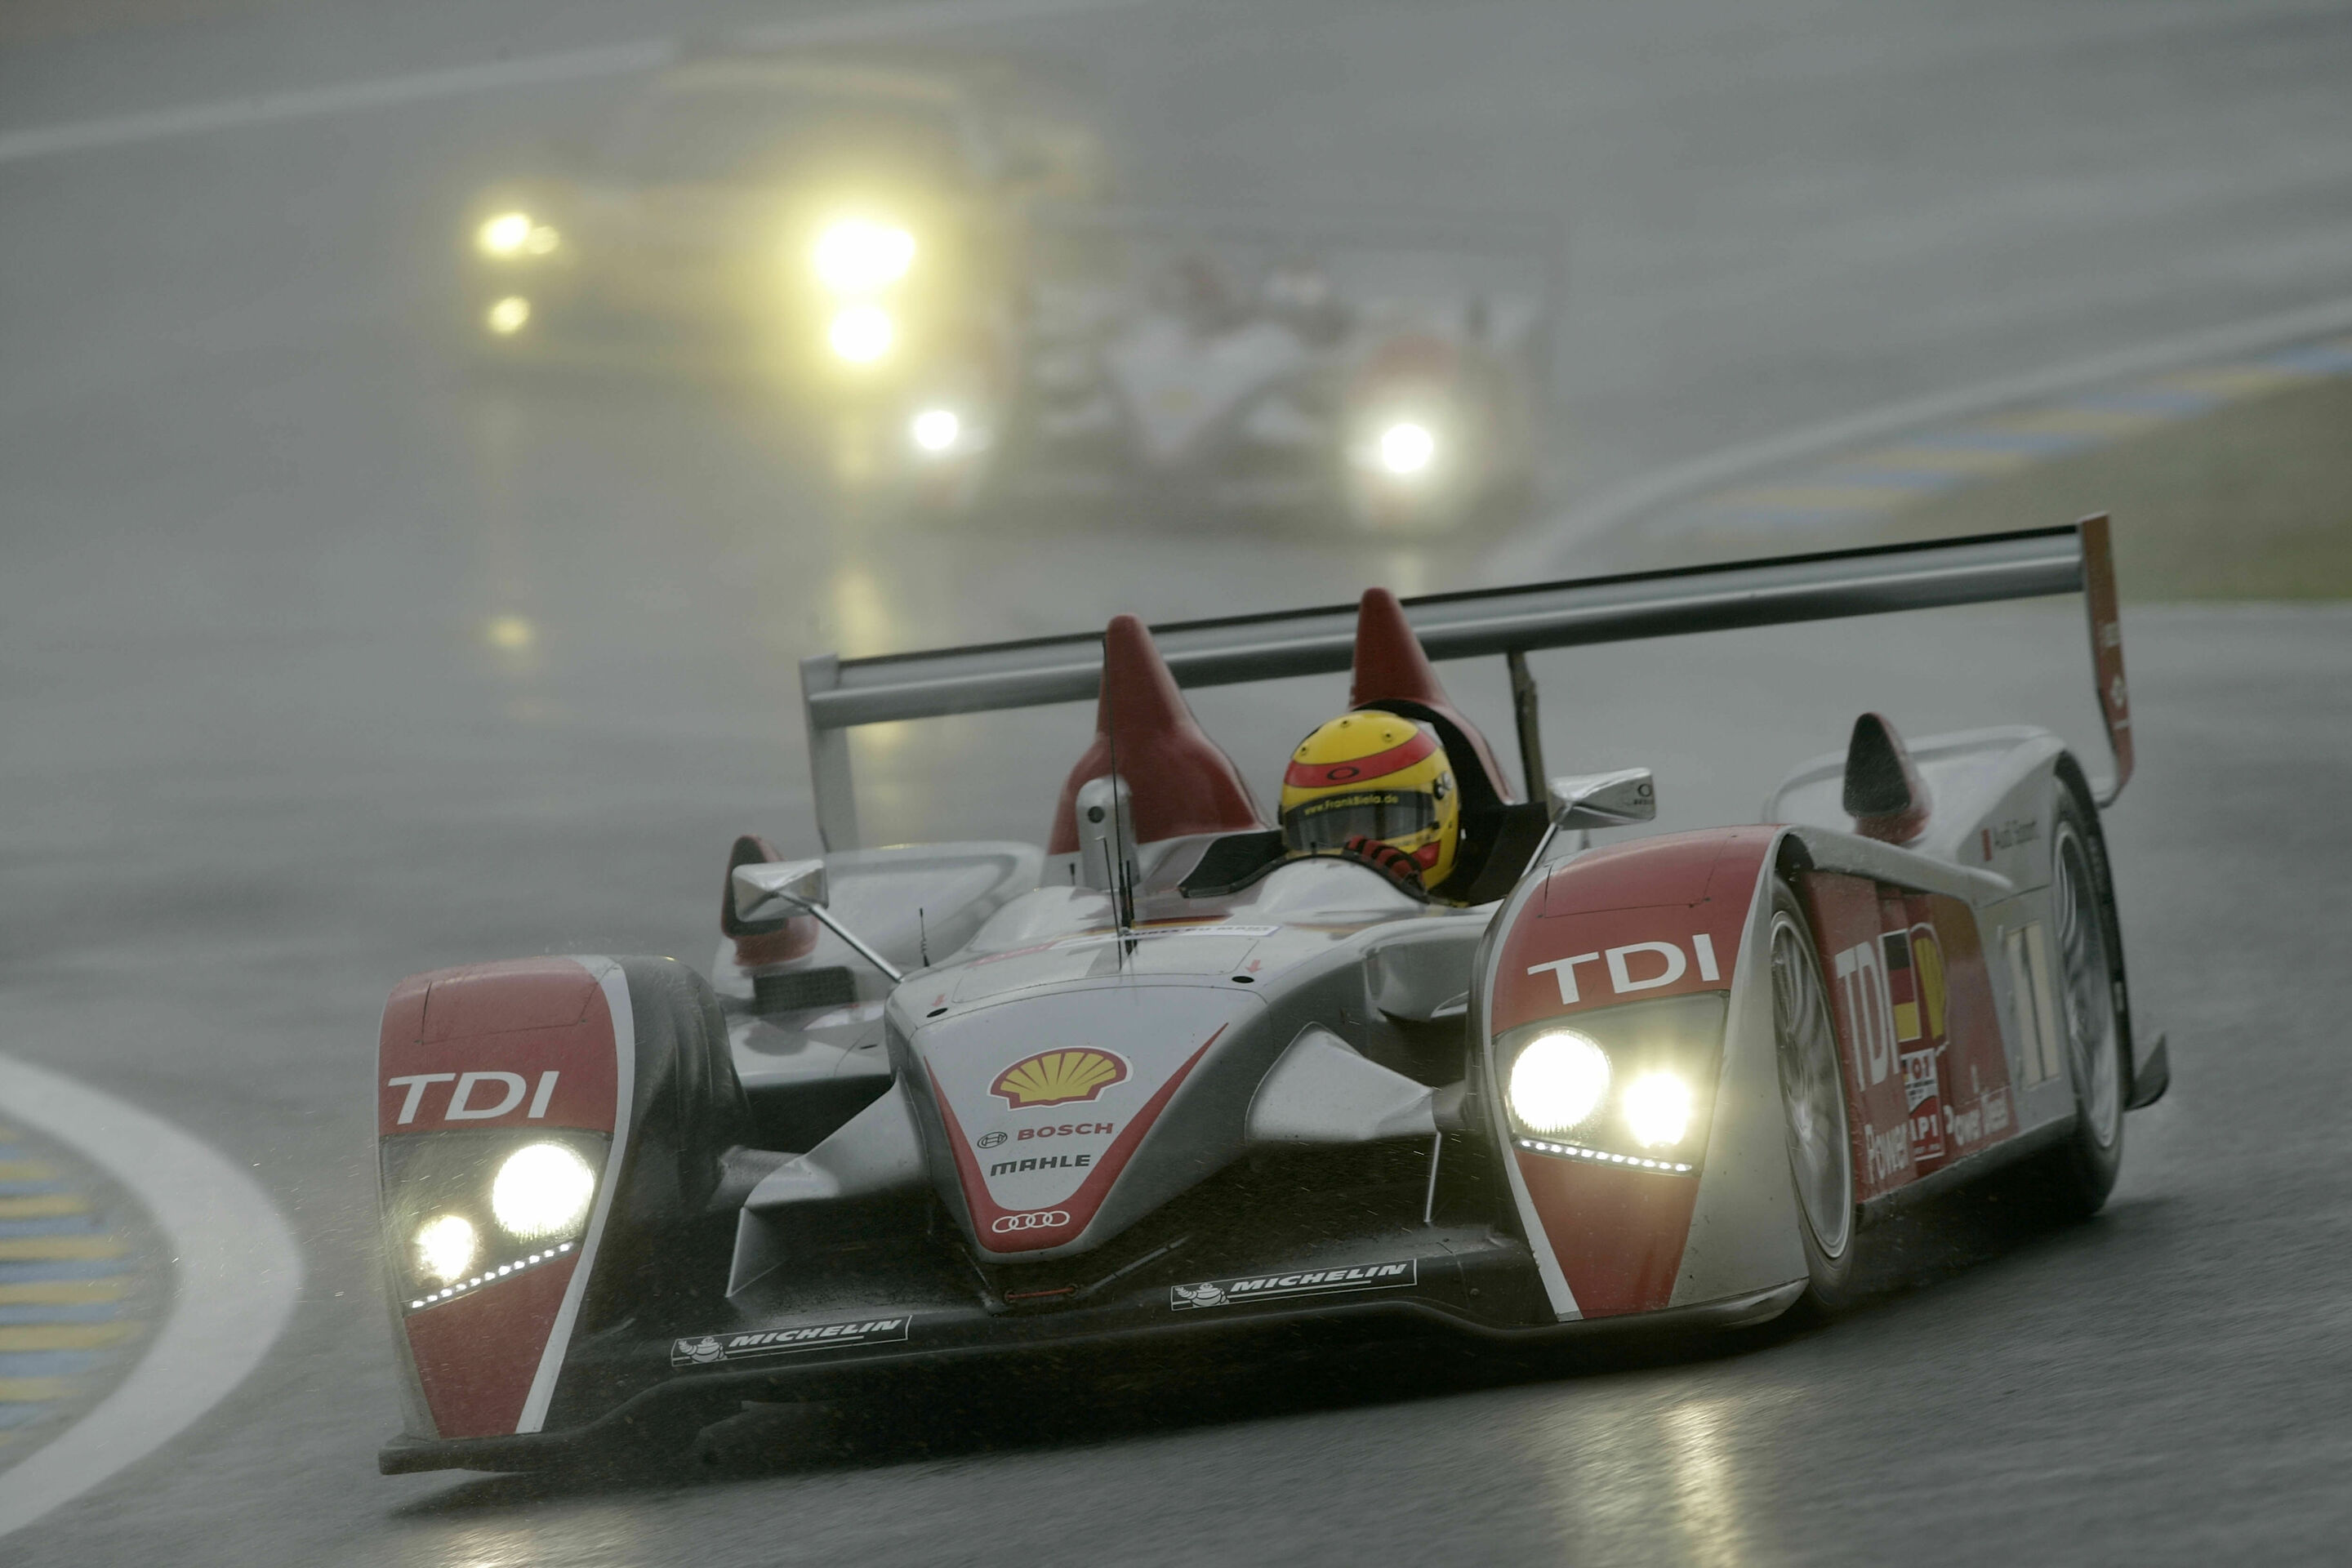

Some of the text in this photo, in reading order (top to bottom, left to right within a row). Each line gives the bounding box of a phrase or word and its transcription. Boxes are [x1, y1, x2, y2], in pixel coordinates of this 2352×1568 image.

[1526, 933, 1721, 1005] TDI
[1834, 938, 1901, 1092] TDI
[387, 1070, 560, 1125] TDI
[1017, 1122, 1114, 1141] BOSCH
[990, 1154, 1091, 1177] MAHLE
[1230, 1263, 1407, 1292] MICHELIN
[728, 1319, 902, 1348] MICHELIN
